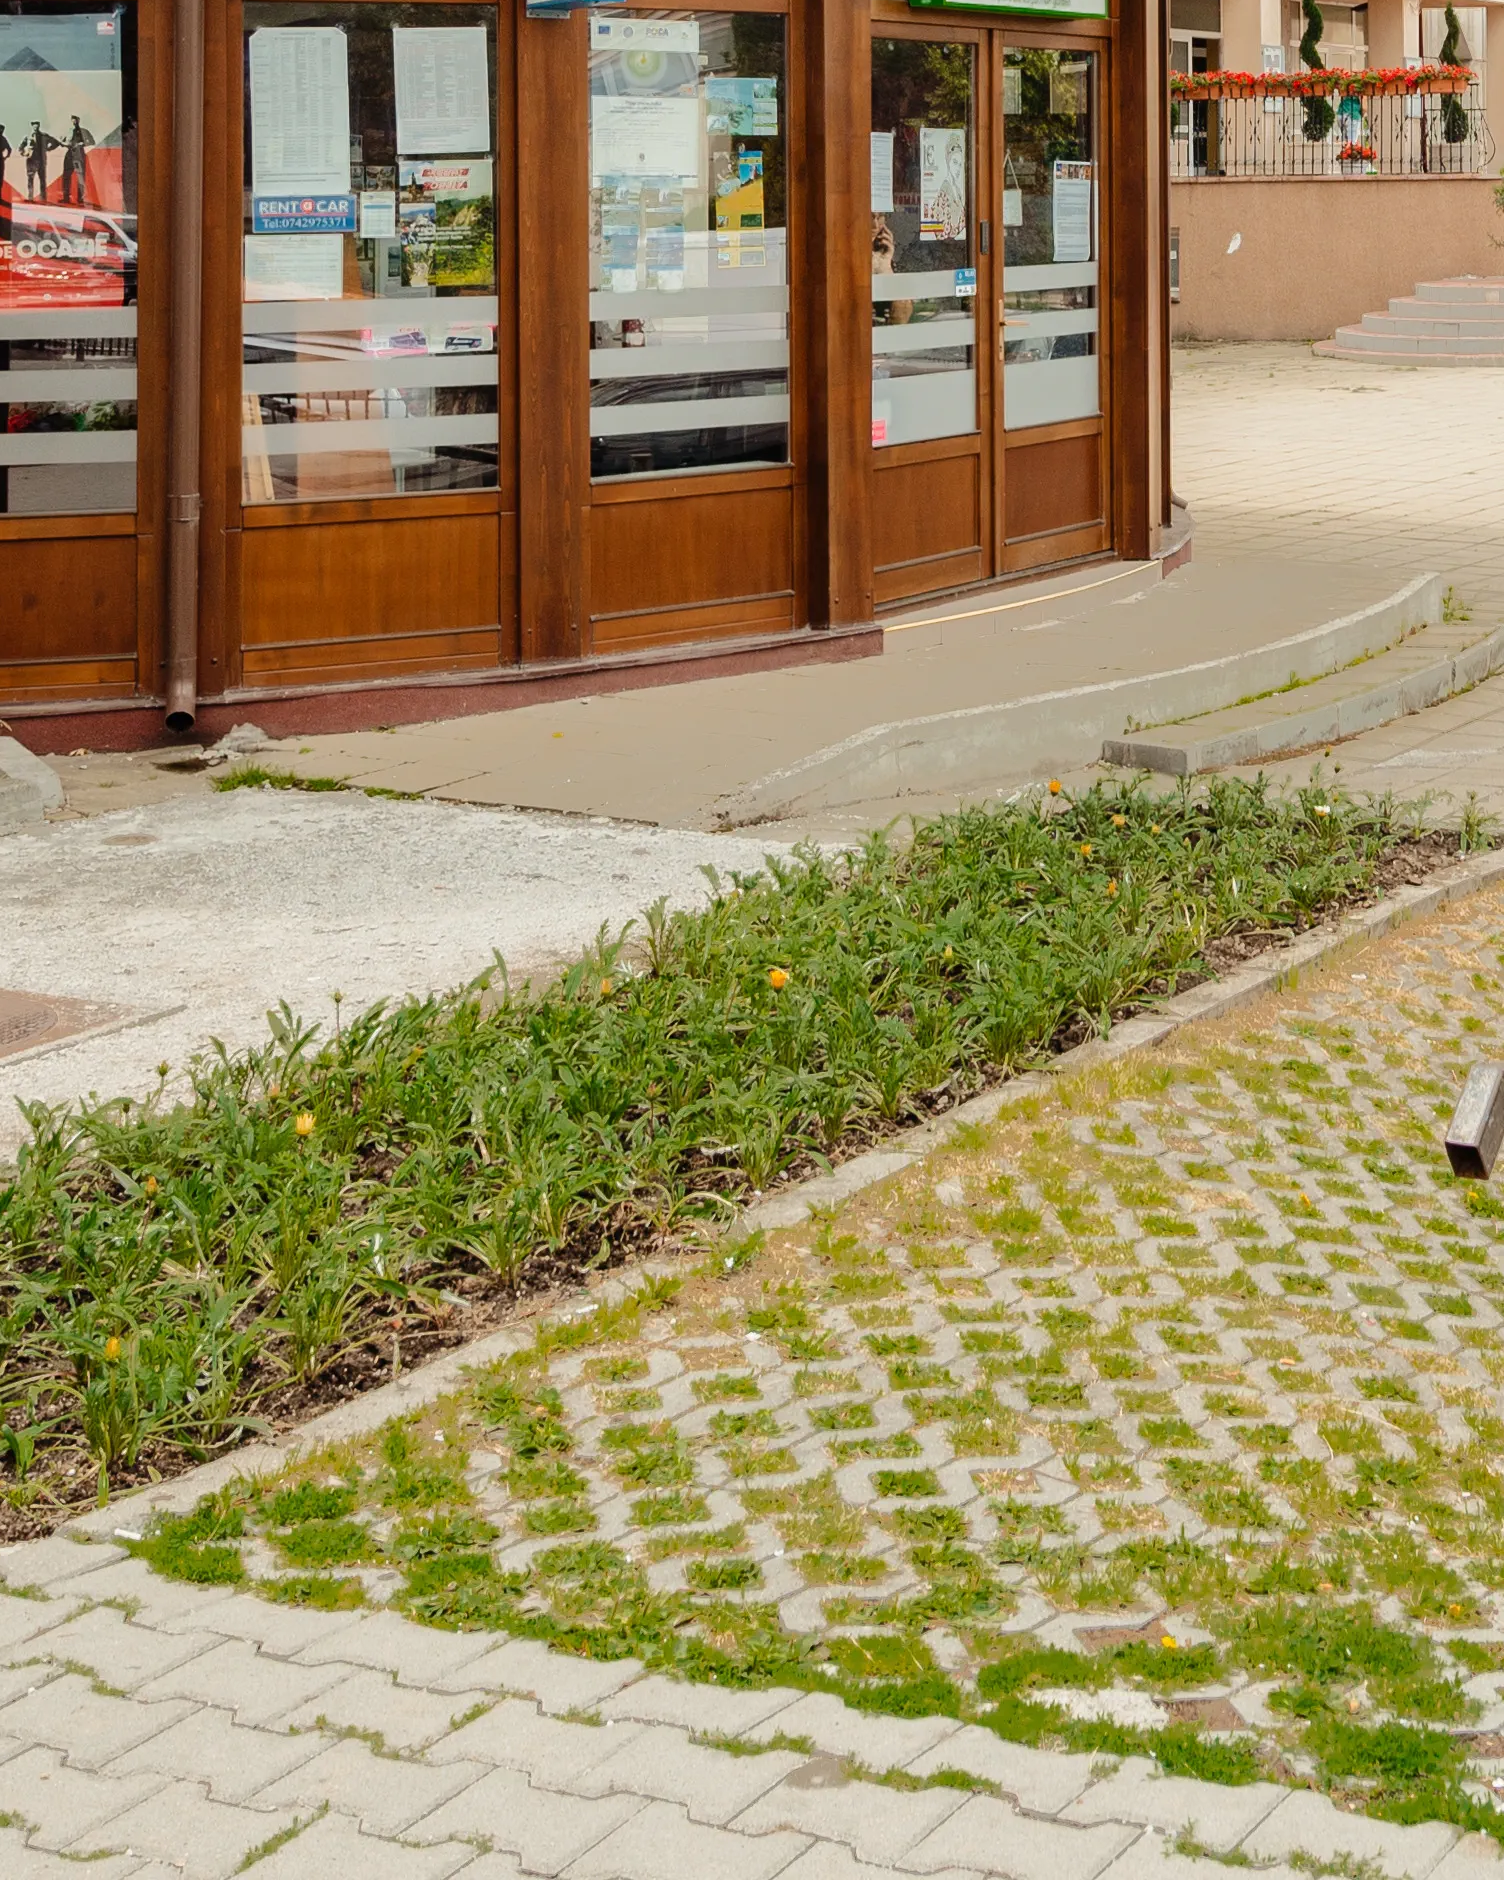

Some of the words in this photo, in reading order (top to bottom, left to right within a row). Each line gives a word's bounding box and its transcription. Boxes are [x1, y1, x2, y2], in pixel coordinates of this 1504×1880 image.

[259, 201, 298, 214] RENT
[316, 200, 349, 213] CAR
[16, 234, 108, 259] OCAZIE
